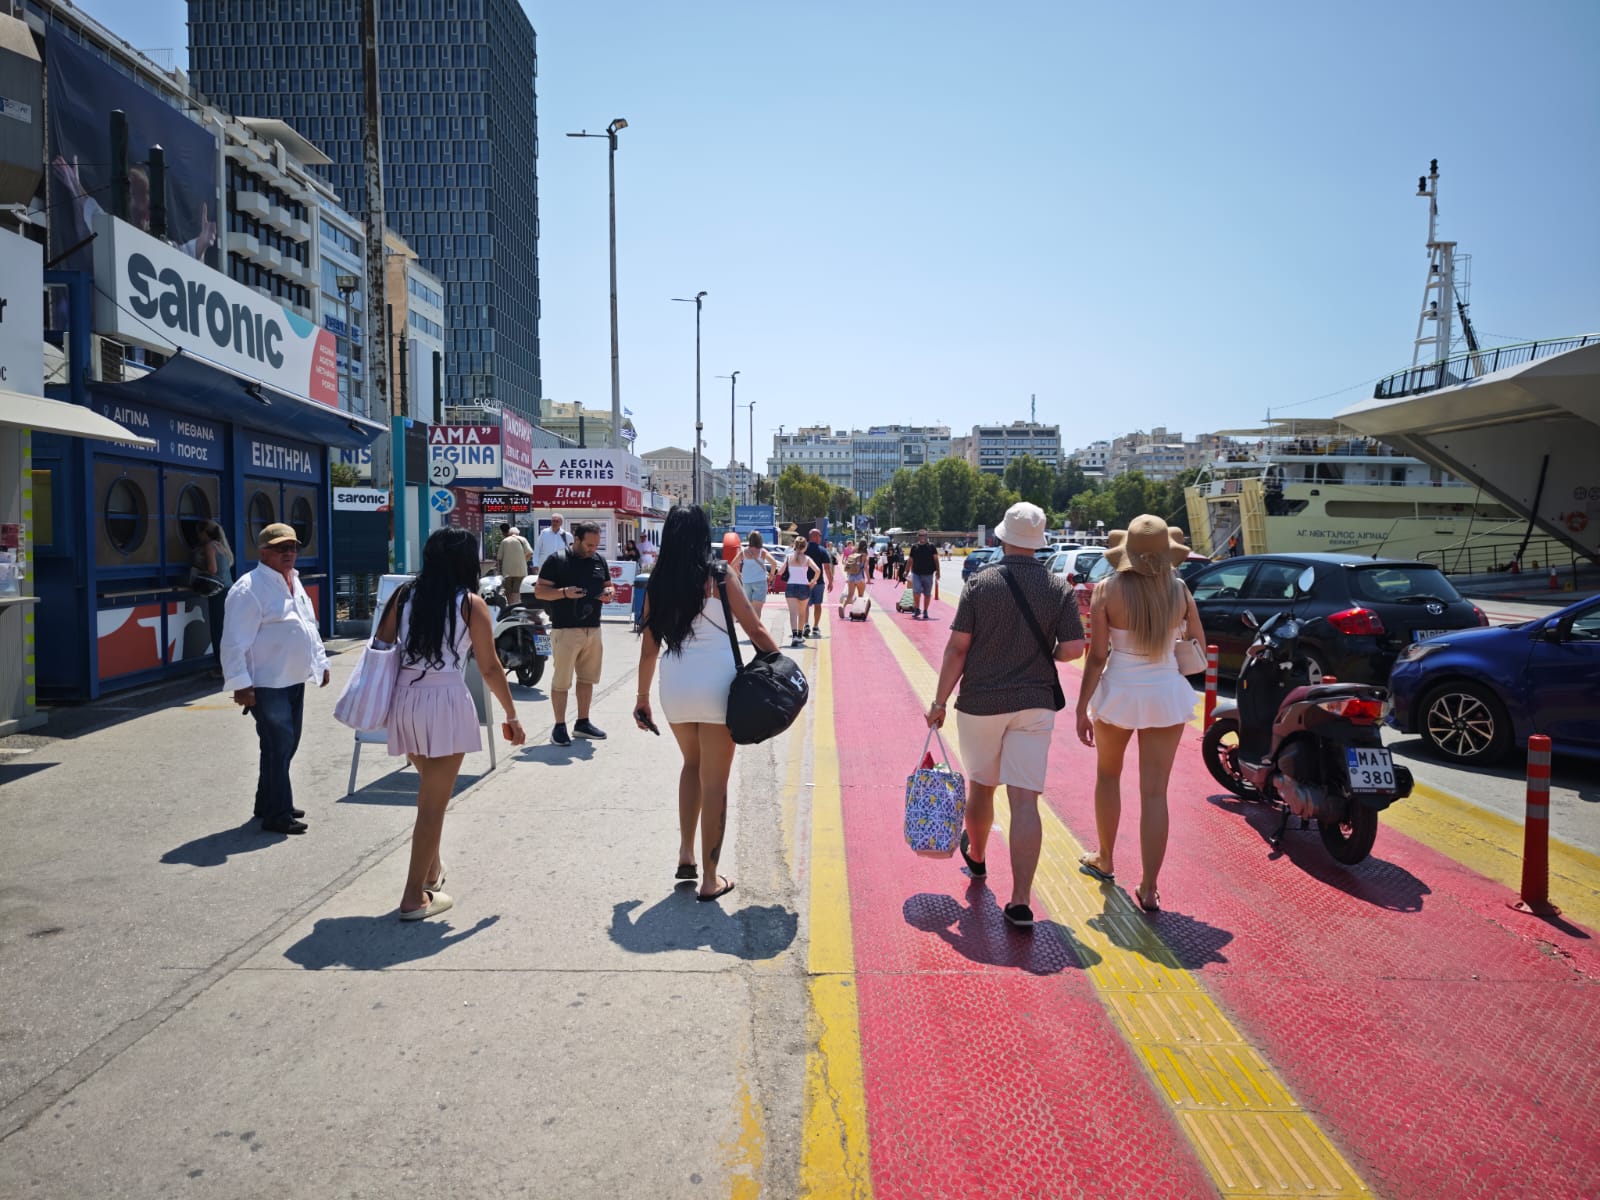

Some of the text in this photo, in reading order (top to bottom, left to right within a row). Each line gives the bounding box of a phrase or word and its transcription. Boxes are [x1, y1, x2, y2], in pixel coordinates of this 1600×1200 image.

[127, 253, 284, 369] saronic
[113, 407, 150, 428] ΑΙΓΙΝΑ
[177, 421, 215, 441] ΜΕΘΑΝΑ
[429, 427, 491, 444] AMA”
[177, 443, 208, 461] ΠΟΡΟΣ
[252, 442, 312, 474] ΕΙΣΙΤΗΡΙΑ
[560, 459, 614, 468] AEGINA
[433, 466, 451, 477] 20
[560, 470, 614, 479] FERRIES
[337, 493, 385, 504] saronic
[555, 487, 592, 498] Eleni
[1361, 771, 1393, 784] 380
